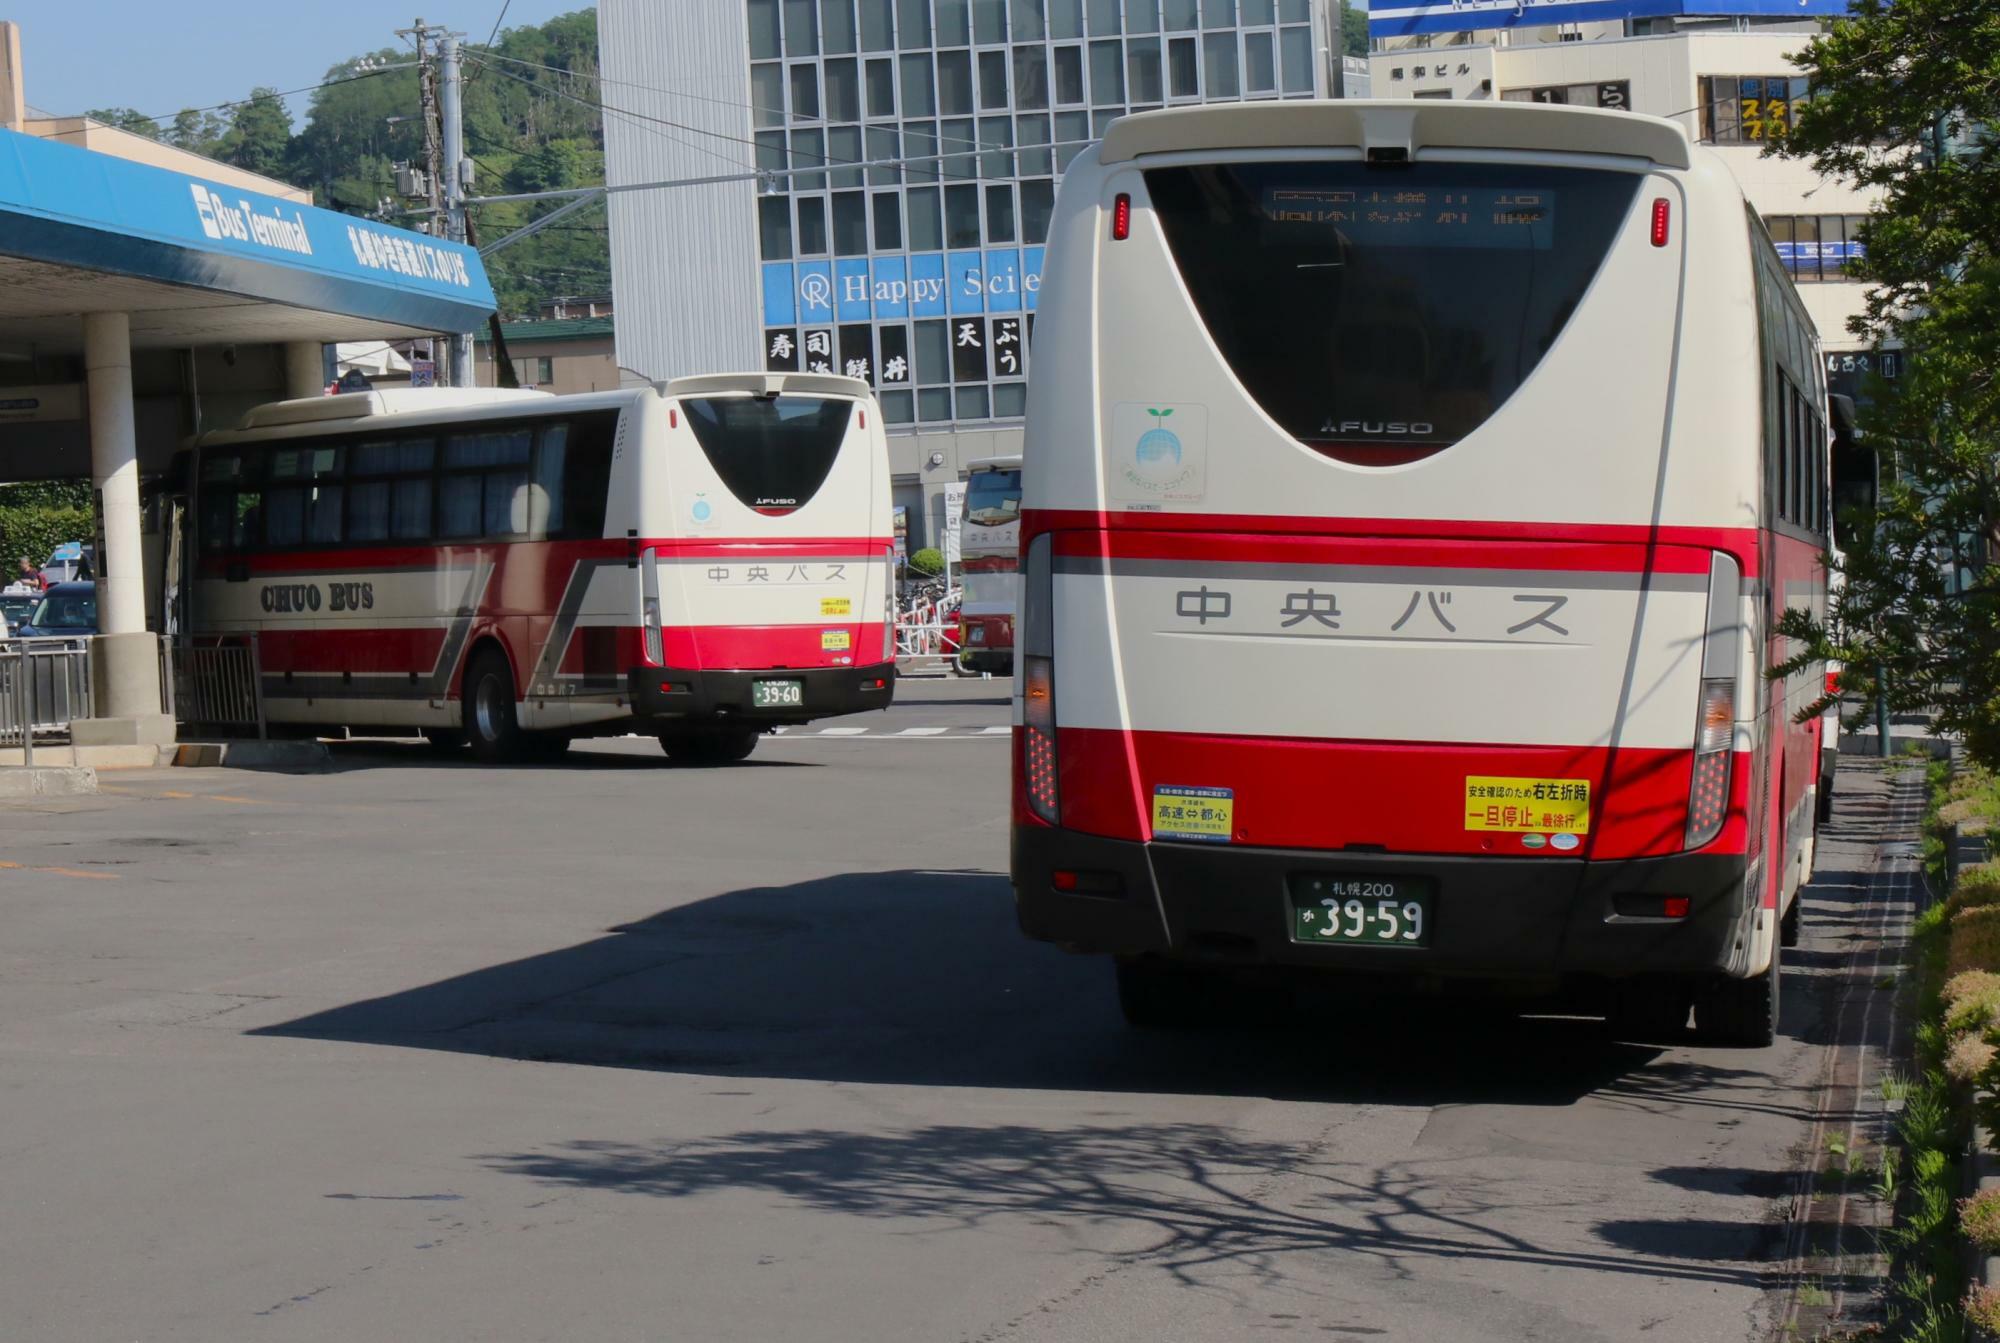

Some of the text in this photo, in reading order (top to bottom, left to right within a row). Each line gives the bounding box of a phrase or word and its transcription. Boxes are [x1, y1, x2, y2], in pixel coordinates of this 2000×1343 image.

[209, 192, 313, 256] Bus Terminal
[843, 266, 1041, 304] Happy Scie
[770, 331, 831, 359] 寿司
[1340, 421, 1433, 435] FUSO
[708, 564, 847, 583] 中央バス
[260, 581, 375, 613] CHUO BUS
[1176, 584, 1570, 637] 中央バス
[762, 686, 800, 703] 39-60
[1333, 881, 1394, 897] 札幌200
[1302, 897, 1423, 940] か 39-59
